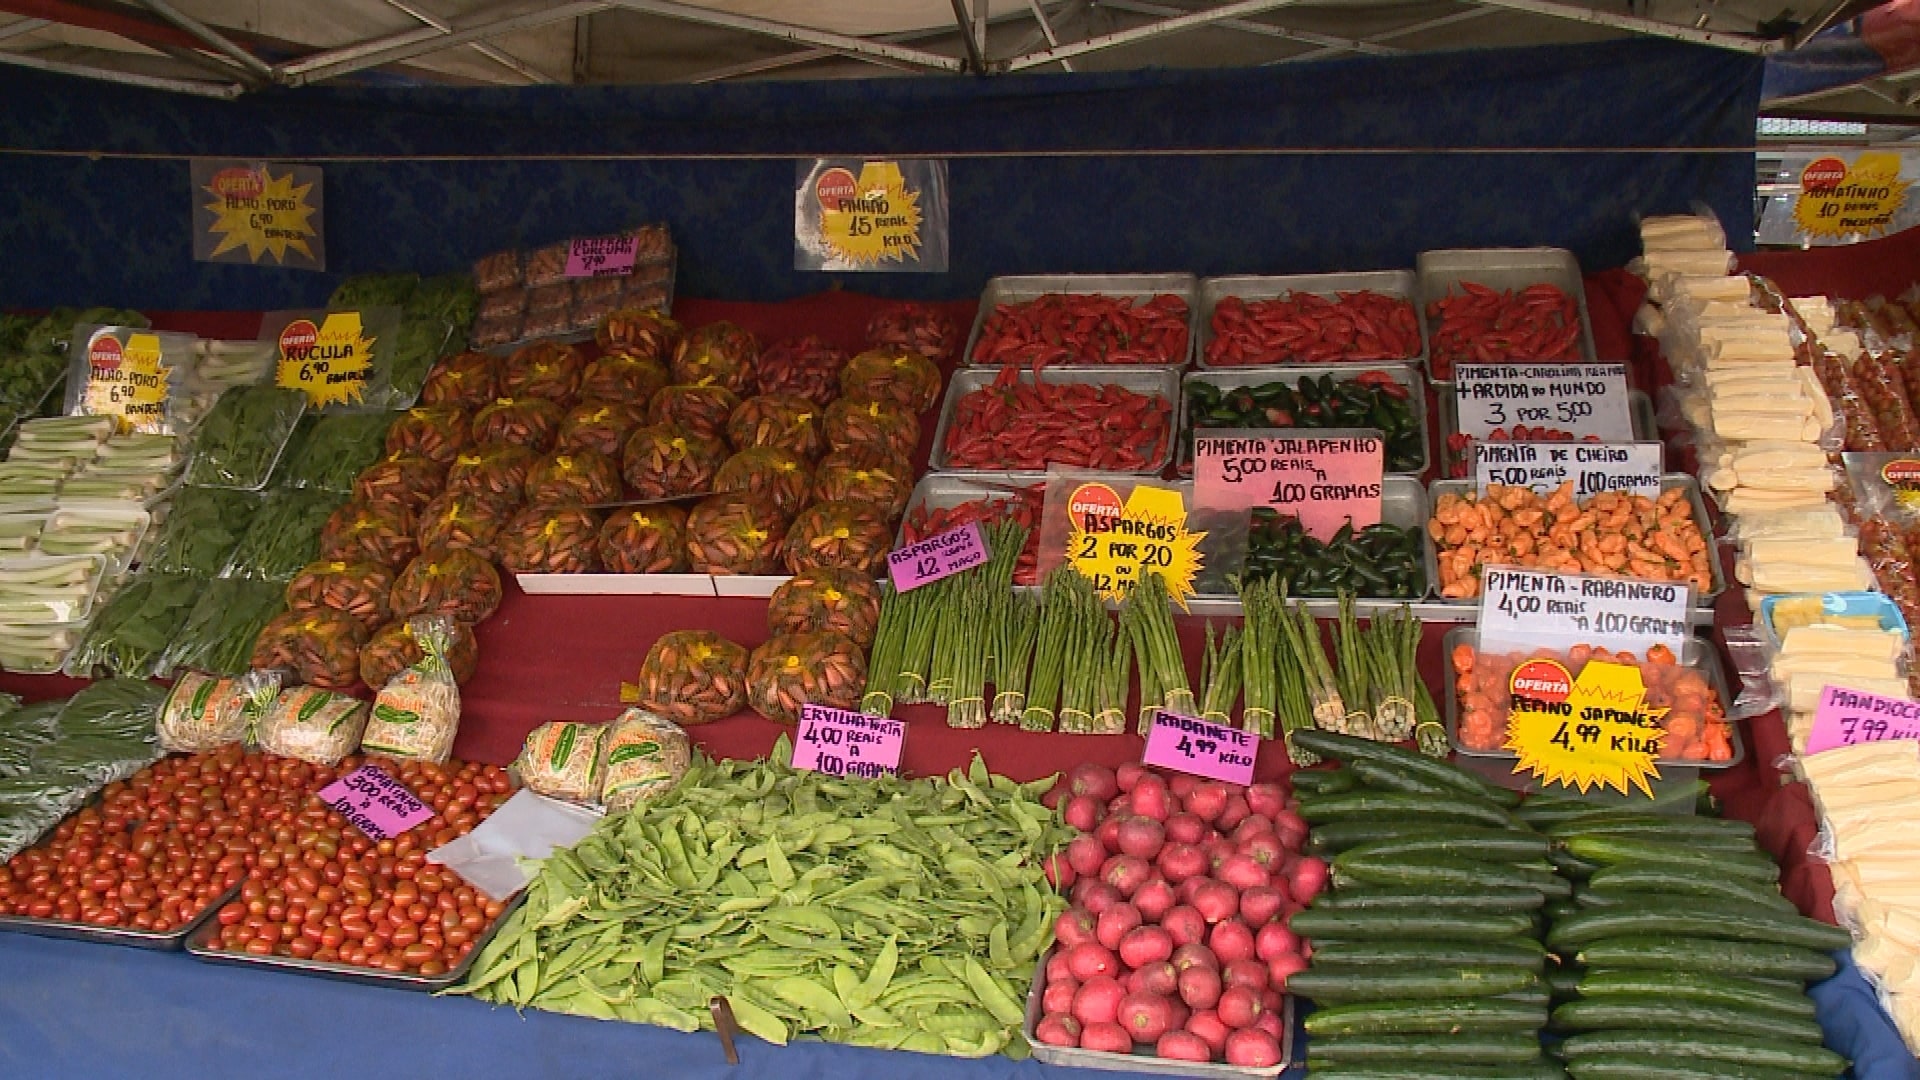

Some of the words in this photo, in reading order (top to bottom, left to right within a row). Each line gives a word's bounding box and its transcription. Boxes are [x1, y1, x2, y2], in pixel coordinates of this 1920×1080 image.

[1804, 171, 1844, 180] OFERTA
[818, 186, 854, 197] OFERTA
[1806, 184, 1889, 199] TOMATINHO
[1816, 202, 1840, 217] 10
[848, 216, 872, 236] 15
[883, 235, 912, 247] KILO
[281, 335, 315, 345] OFERTA
[91, 351, 121, 361] OFERTA
[299, 361, 329, 382] 6,90
[1550, 381, 1606, 397] MUNDO
[1484, 402, 1506, 425] 3
[1516, 407, 1549, 421] POR
[1197, 439, 1266, 456] PIMENTA
[1274, 439, 1377, 454] JALAPENHO
[1475, 444, 1537, 463] PIMENTA
[1550, 448, 1568, 462] DE
[1576, 446, 1628, 462] CHEIRO
[1271, 459, 1314, 471] REAIS
[1530, 464, 1567, 480] REAIS
[1576, 470, 1606, 495] 100
[1607, 474, 1660, 492] GRAMAS
[1886, 471, 1920, 480] OFER
[1268, 481, 1305, 504] 100
[1310, 483, 1380, 500] GRAMAS
[1071, 501, 1120, 518] OFERTA
[1084, 514, 1176, 542] ASPARGOS
[891, 527, 971, 564] ASPARGOS
[1078, 536, 1098, 559] 2
[1109, 542, 1138, 560] POR
[1140, 544, 1173, 567] 20
[915, 557, 940, 580] 12
[1115, 566, 1132, 575] OU
[1094, 573, 1111, 591] 12
[1488, 571, 1565, 594] PIMENTA
[1498, 593, 1540, 619] 4,00
[1546, 600, 1587, 615] REAIS
[1594, 612, 1627, 634] 100
[1514, 678, 1569, 694] OFERTA
[1511, 693, 1572, 717] PEPINO
[846, 729, 884, 745] REAIS
[1156, 711, 1252, 746] RABANETE
[1840, 717, 1889, 745] 7,99
[1610, 731, 1659, 755] KILO
[816, 752, 844, 775] 100
[1218, 749, 1253, 767] KILO
